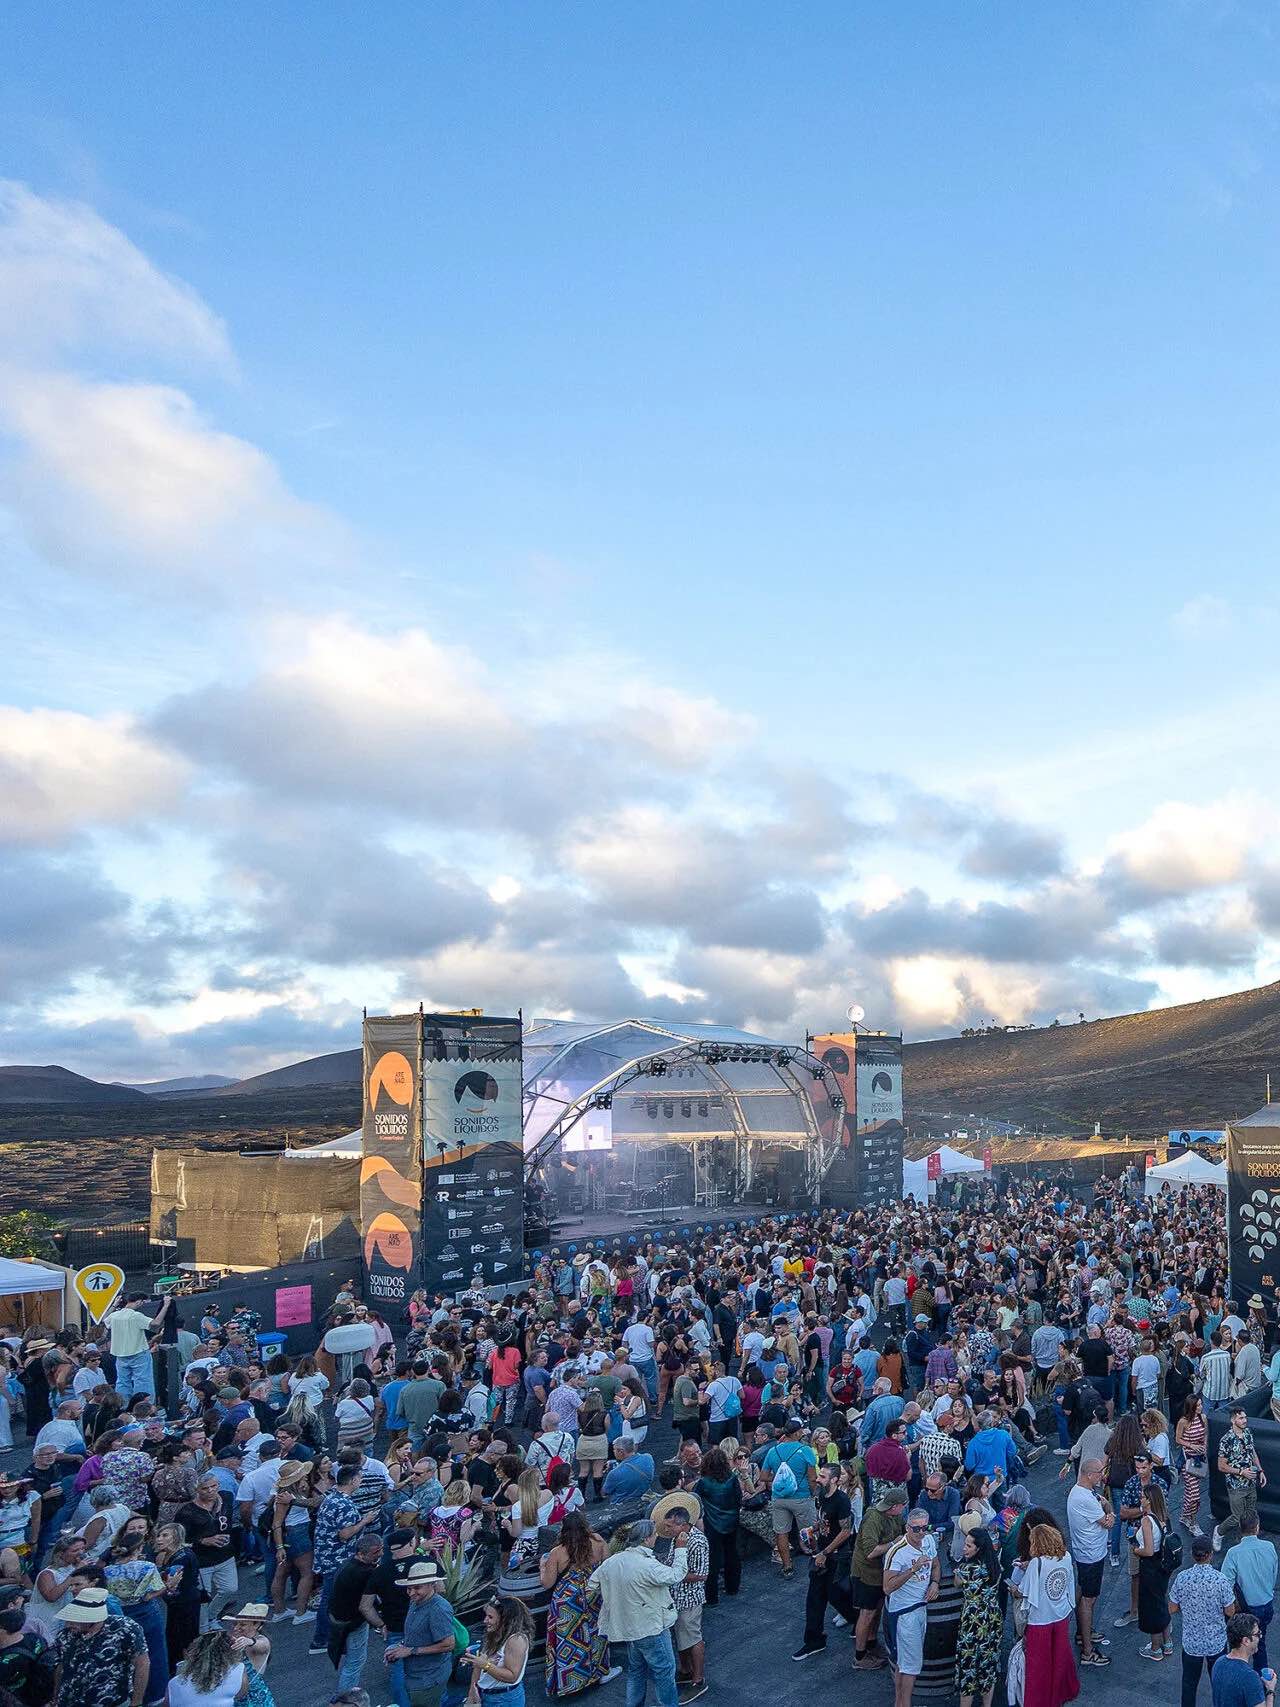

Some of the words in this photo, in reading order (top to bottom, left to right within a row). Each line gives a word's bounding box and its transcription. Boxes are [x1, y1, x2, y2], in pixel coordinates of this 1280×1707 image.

[375, 1113, 409, 1125] SONIDOS
[454, 1116, 500, 1126] SONIDOS
[370, 1274, 405, 1288] SONIDOS
